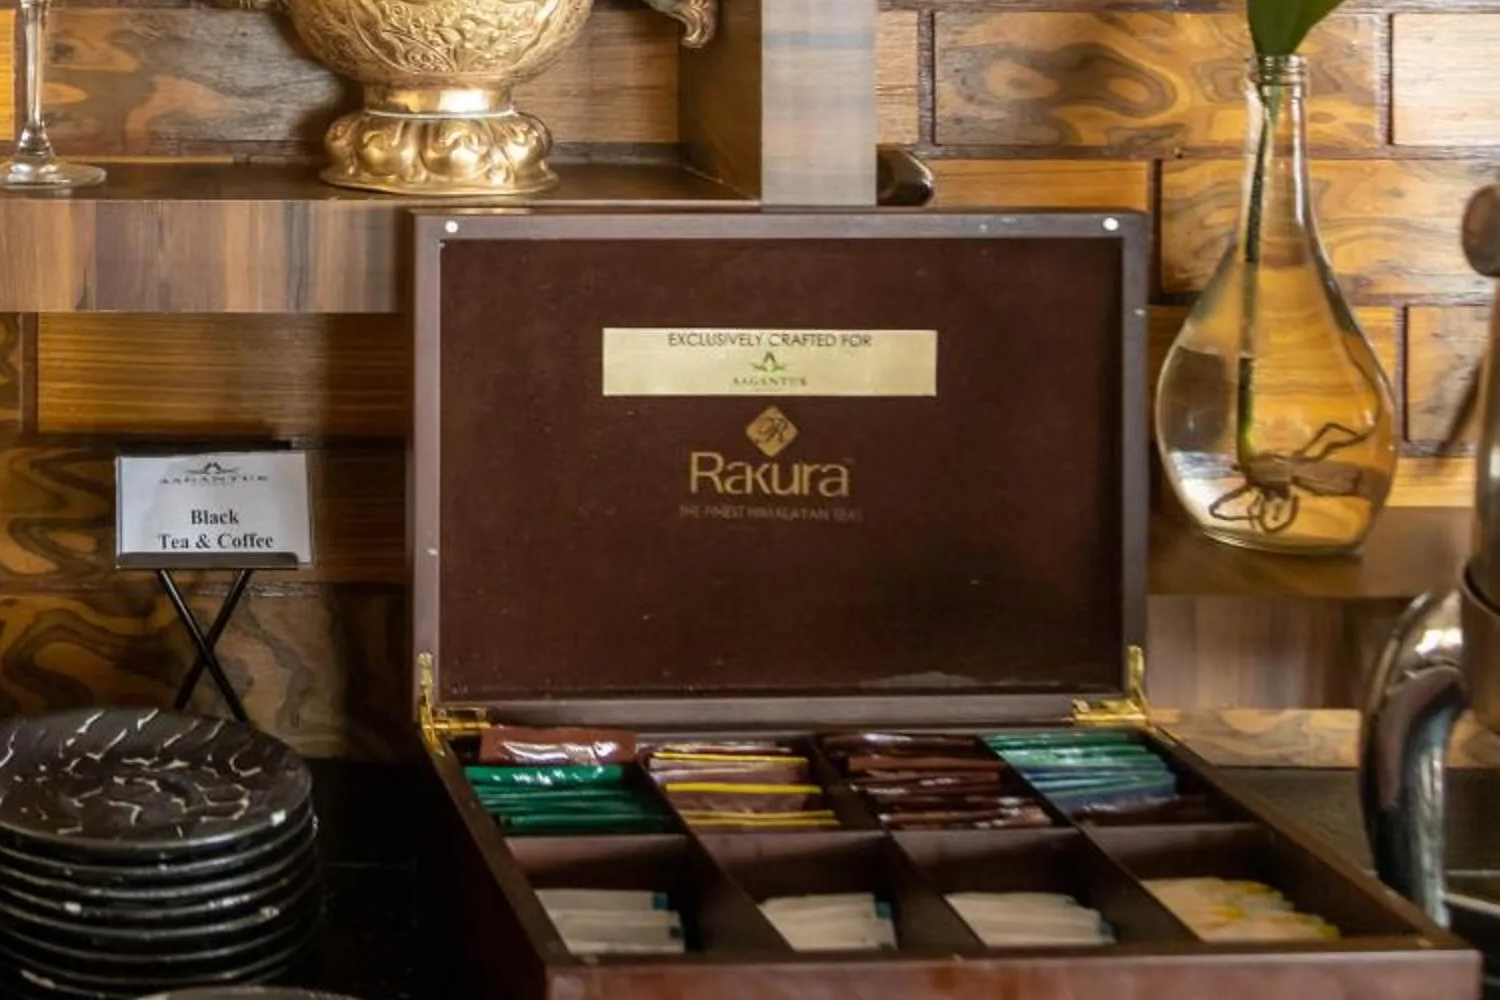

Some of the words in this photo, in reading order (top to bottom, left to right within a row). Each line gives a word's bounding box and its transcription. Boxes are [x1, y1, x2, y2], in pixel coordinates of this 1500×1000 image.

[668, 332, 763, 347] EXCLUSIVELY
[767, 332, 837, 347] CRAFTED
[842, 333, 872, 348] FOR
[689, 451, 850, 497] Rakura
[191, 509, 240, 525] Black
[158, 534, 189, 549] Tea
[195, 534, 211, 549] &
[217, 532, 274, 549] Coffee
